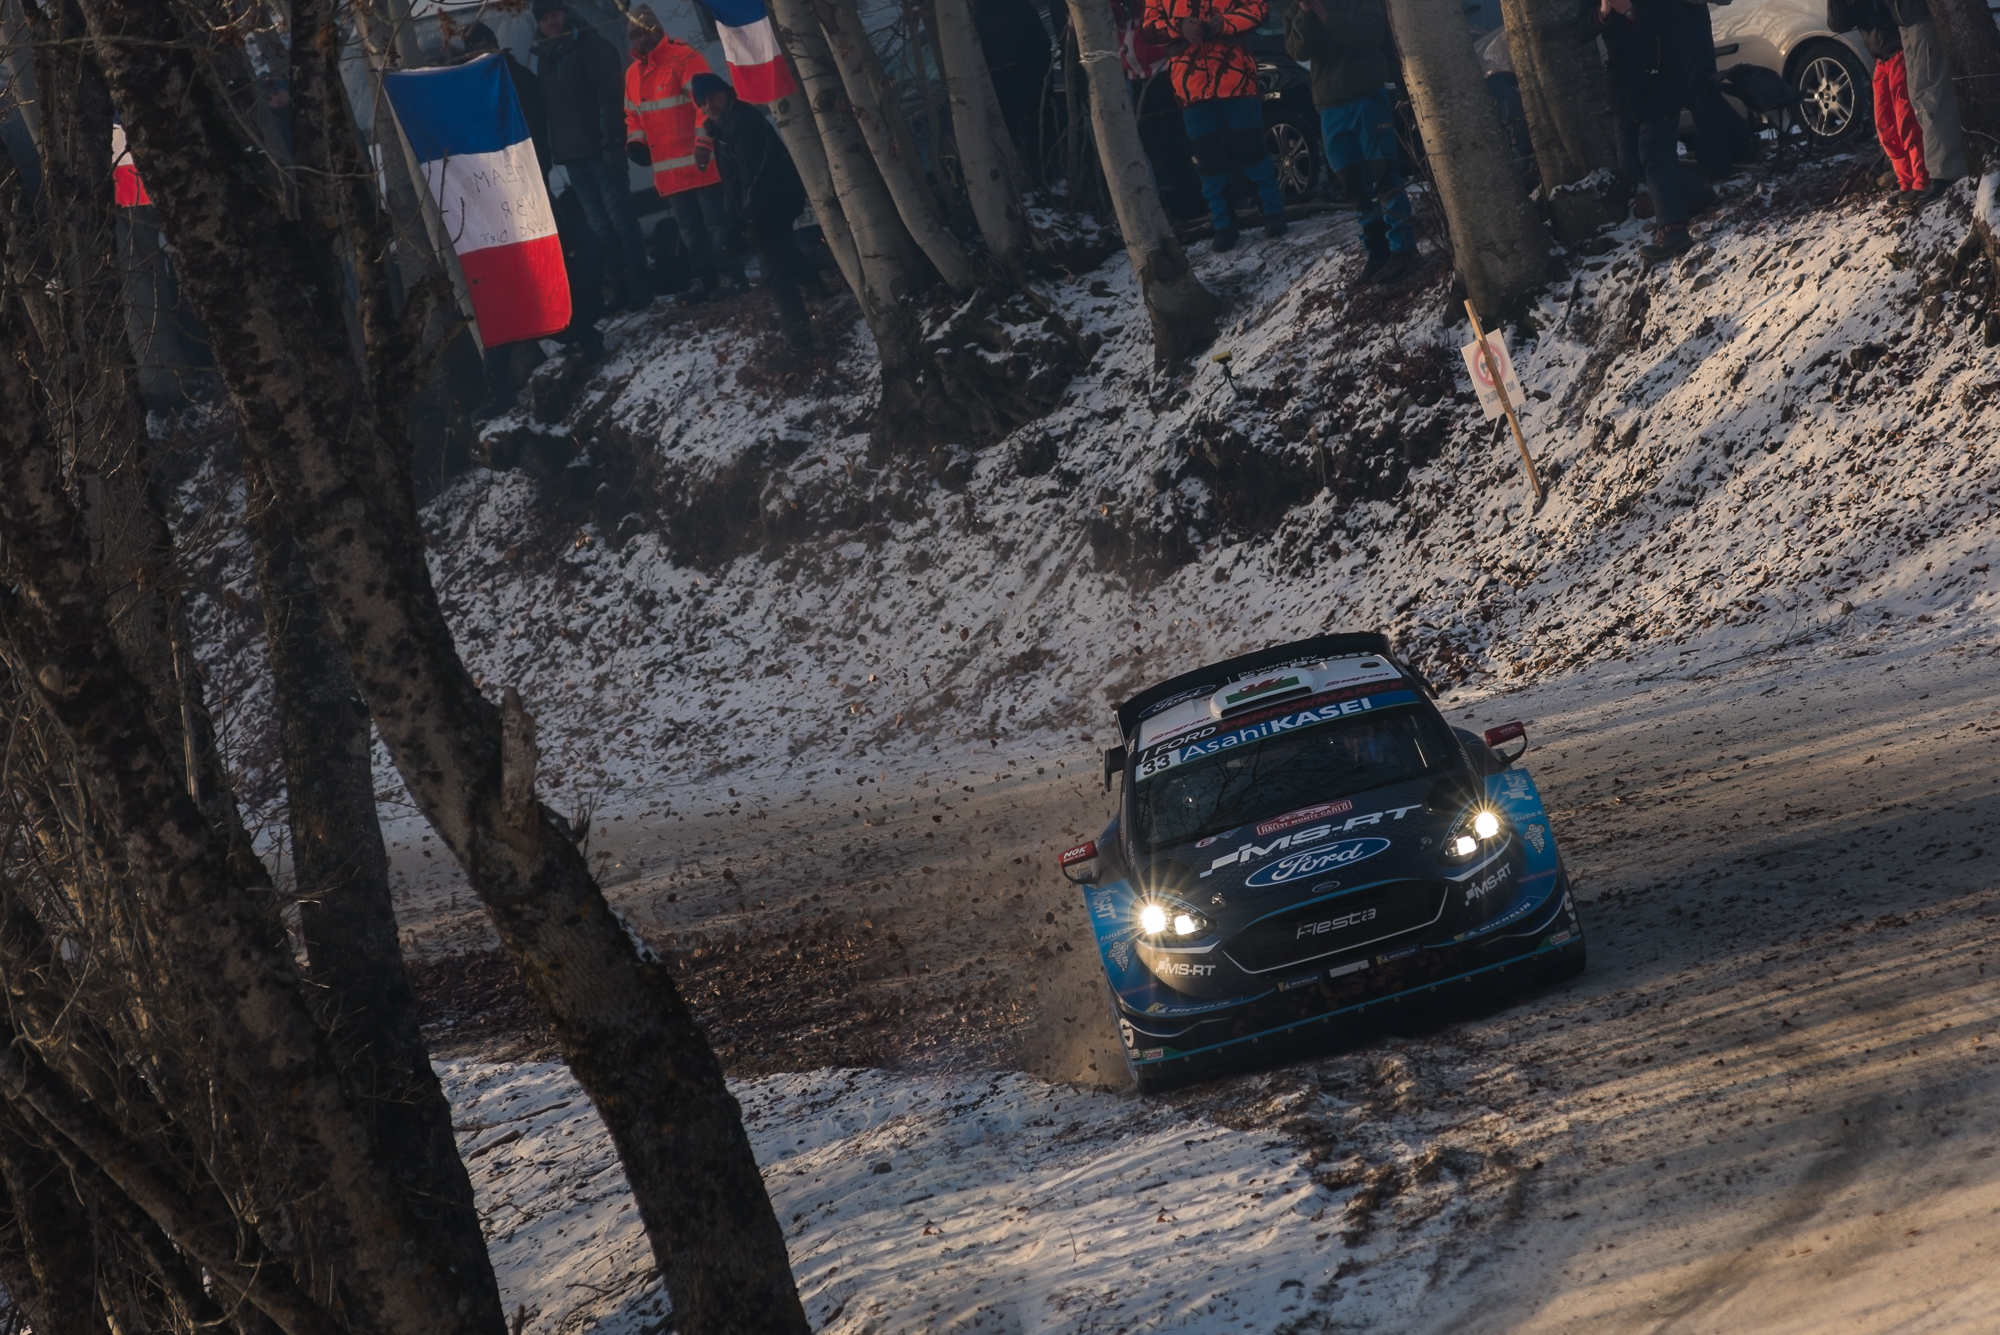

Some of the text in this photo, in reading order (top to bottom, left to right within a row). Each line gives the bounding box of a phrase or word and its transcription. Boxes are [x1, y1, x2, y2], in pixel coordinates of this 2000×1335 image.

[1155, 727, 1216, 755] FORD
[1220, 681, 1404, 731] PERFORMANCE
[1143, 754, 1171, 776] 33
[1514, 810, 1543, 822] AUDES
[1239, 804, 1422, 863] MS-RT
[1063, 846, 1087, 859] NGK
[1271, 842, 1363, 881] Ford
[1296, 908, 1376, 940] Fiesta
[1480, 902, 1531, 933] MICHELIN
[1389, 948, 1416, 959] MICHELIN
[1290, 976, 1318, 986] MICHELIN
[1169, 1001, 1231, 1013] MICHELIN
